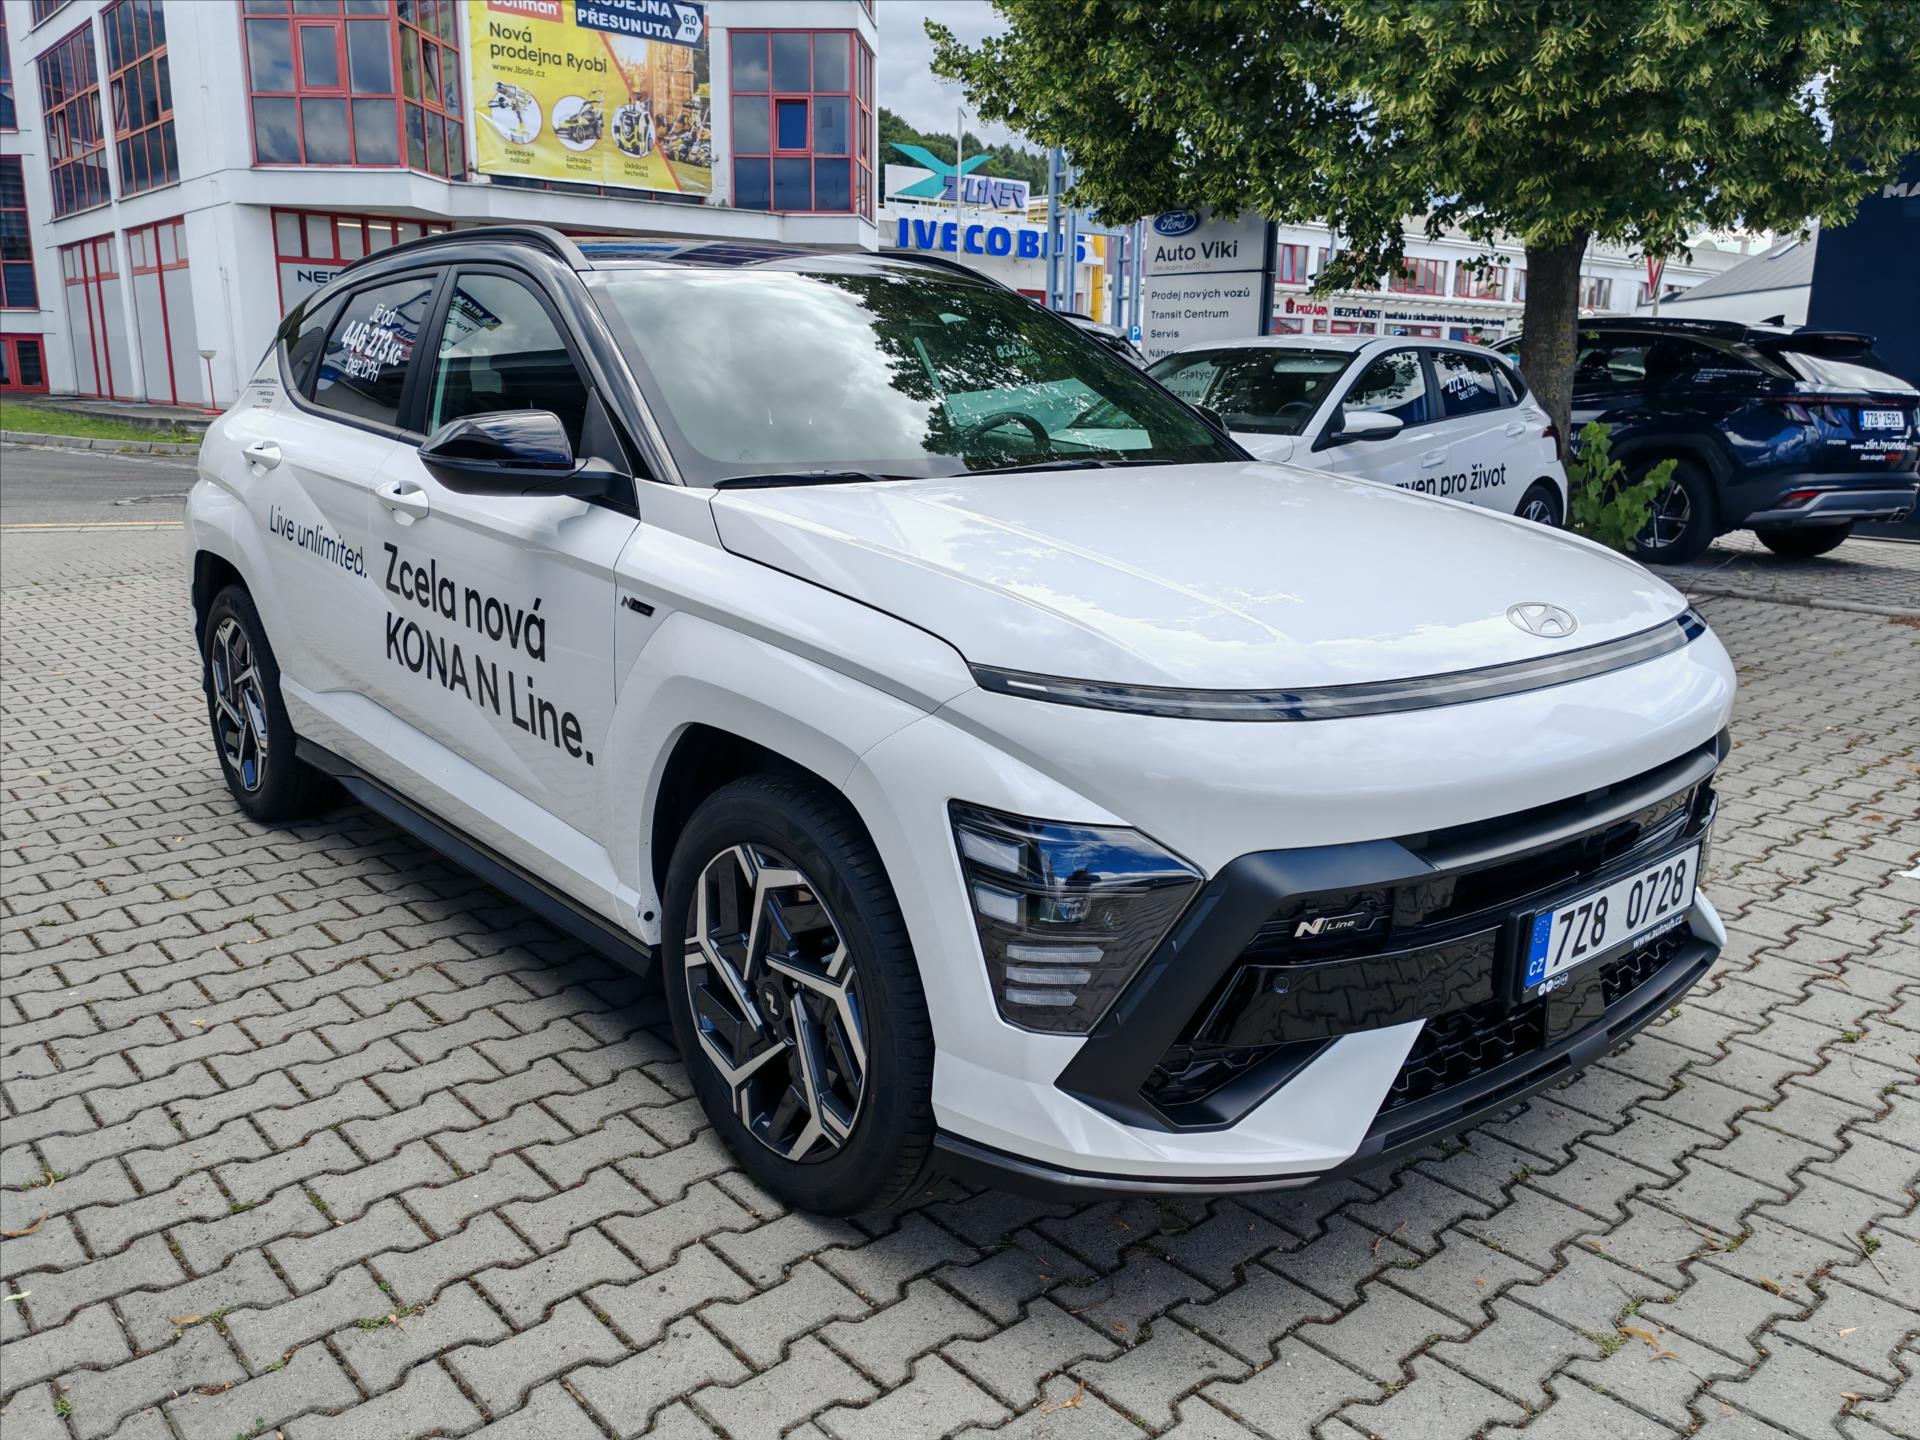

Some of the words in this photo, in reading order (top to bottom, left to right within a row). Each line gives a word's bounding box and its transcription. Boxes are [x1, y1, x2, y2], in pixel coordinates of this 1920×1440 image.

[577, 8, 674, 39] PŘESUNUTA
[683, 14, 698, 25] 60
[685, 27, 696, 35] m
[489, 22, 532, 43] Nová
[490, 43, 562, 67] prodejna
[566, 53, 607, 73] Ryobi
[1161, 213, 1188, 230] Ford
[898, 217, 1012, 256] IVECO
[1155, 245, 1196, 263] Auto
[1201, 240, 1238, 259] Viki
[1151, 291, 1181, 301] Prodej
[1183, 287, 1221, 300] nových
[1223, 286, 1250, 298] vozů
[369, 303, 385, 323] Již
[381, 307, 399, 326] od
[1151, 310, 1182, 319] Transit
[1184, 309, 1229, 319] Centrum
[1296, 303, 1328, 315] POŽÁRN
[1333, 306, 1382, 318] BEZPEČNOST
[341, 320, 370, 353] 446
[364, 327, 393, 361] 273
[386, 343, 404, 366] Kč
[1150, 329, 1179, 338] Servis
[345, 353, 361, 376] bez
[360, 358, 382, 383] DPH
[1440, 473, 1467, 497] pro
[1470, 463, 1506, 490] život
[269, 505, 295, 541] Live
[297, 521, 368, 579] unlimited.
[384, 542, 457, 621] Zcela
[464, 586, 546, 662] nová
[386, 611, 473, 700] KONA
[475, 654, 501, 716] N
[509, 670, 594, 767] Line.
[1551, 895, 1609, 968] 7Z8
[1625, 858, 1686, 930] 0728
[1294, 918, 1325, 937] N
[1327, 920, 1355, 931] Line
[1528, 957, 1545, 977] CZ
